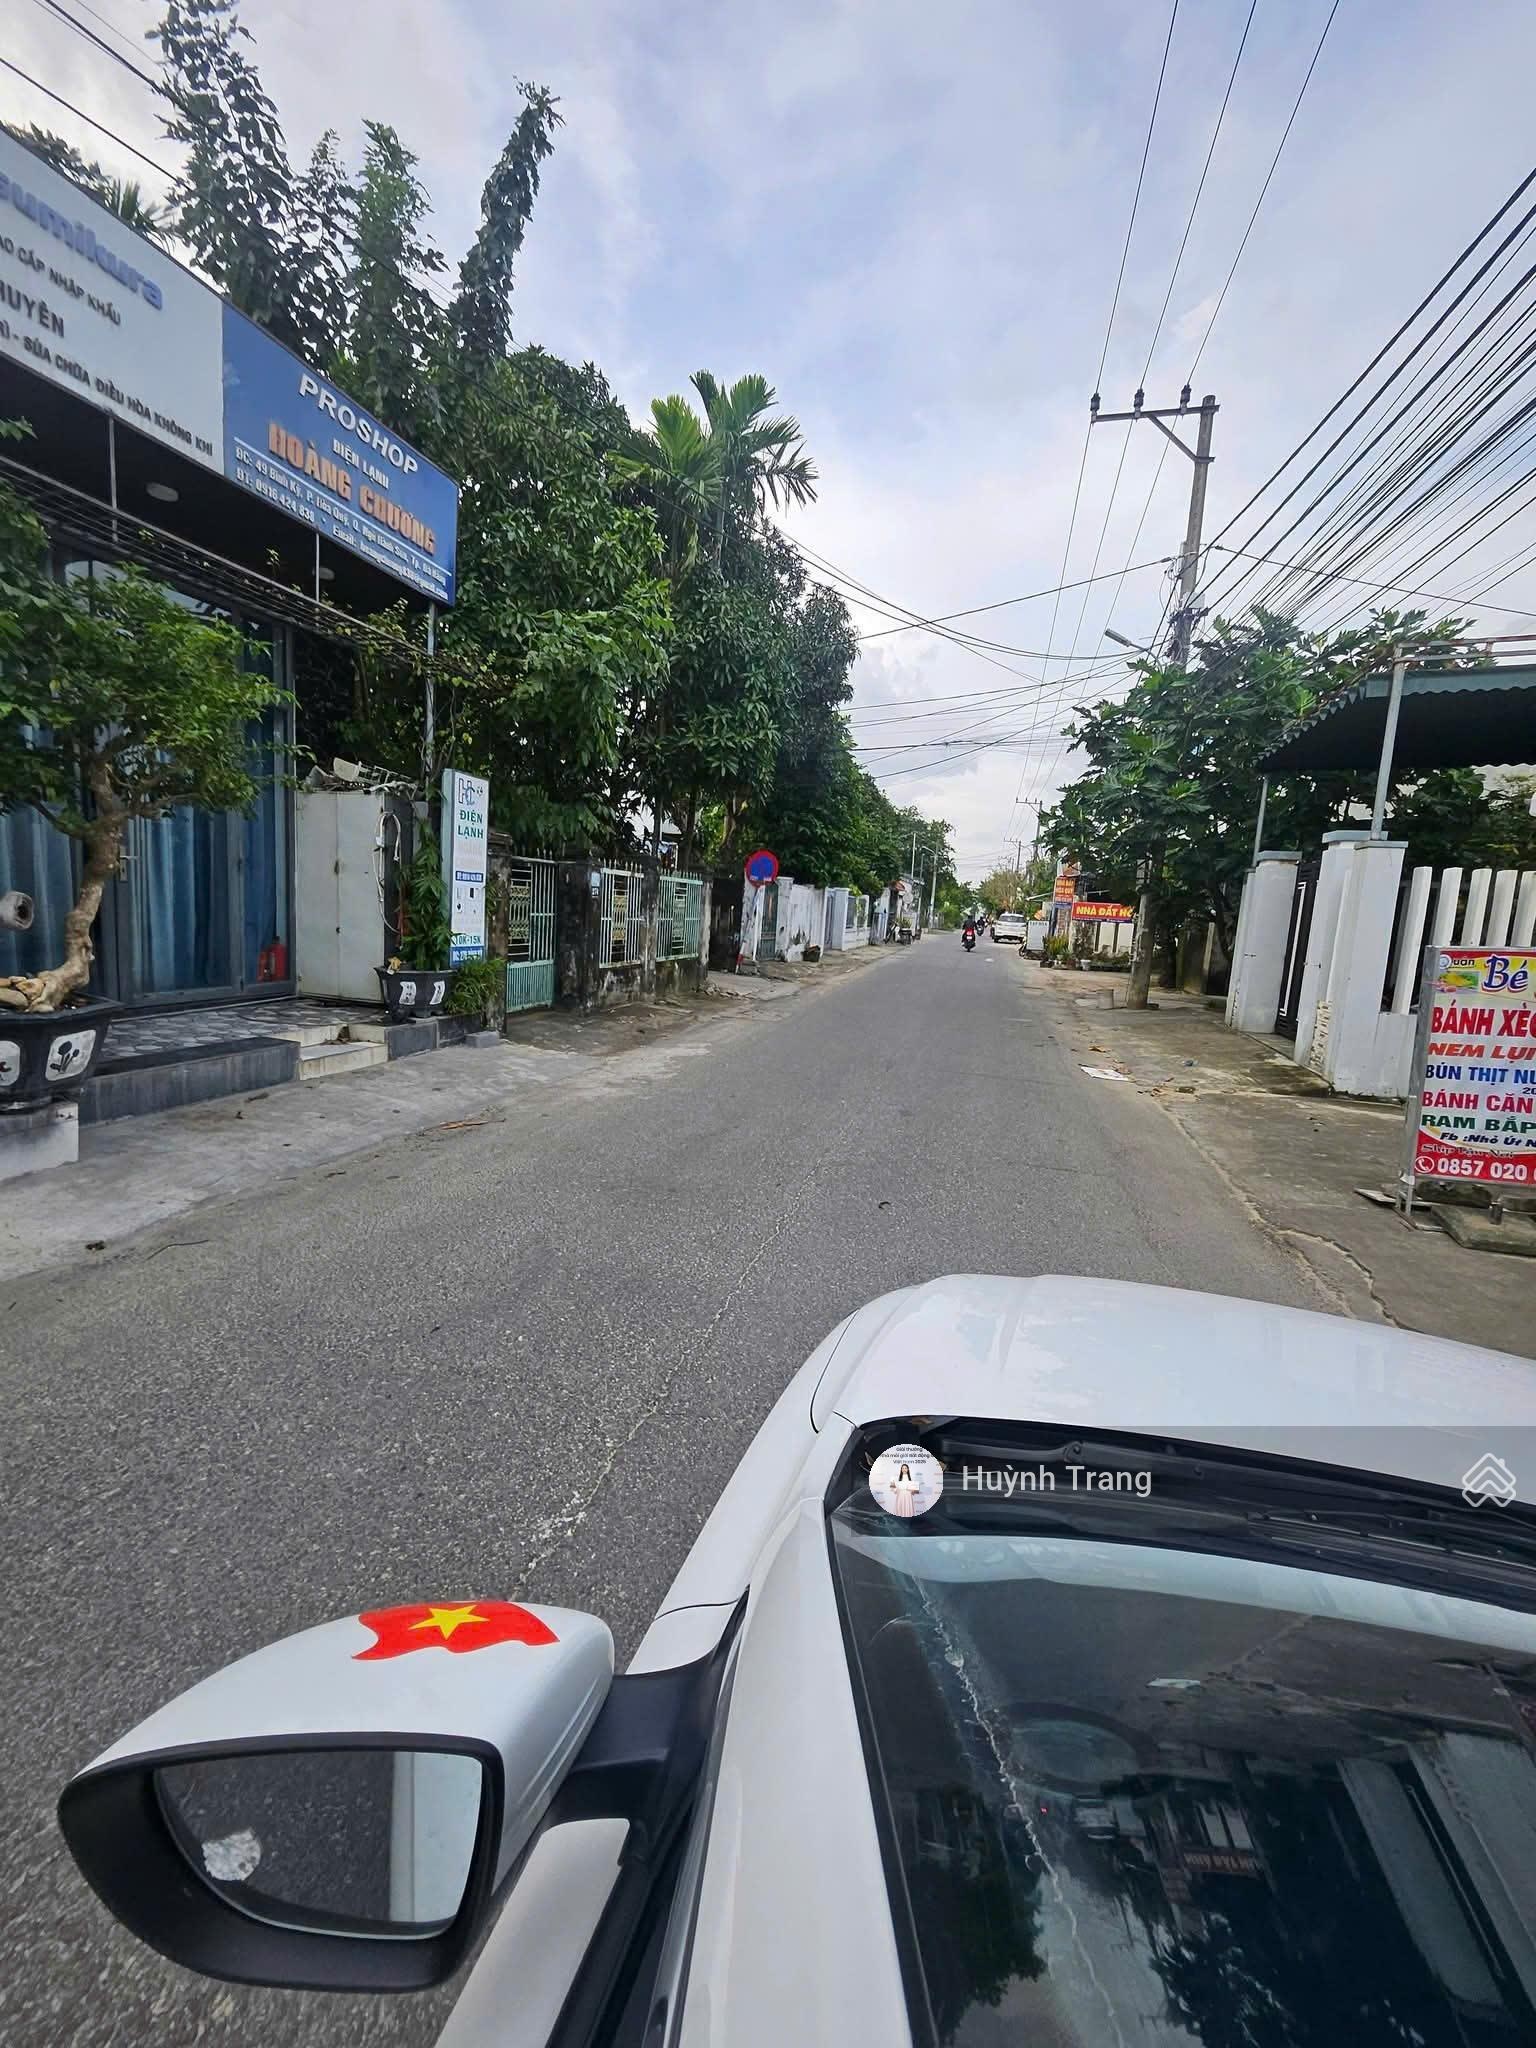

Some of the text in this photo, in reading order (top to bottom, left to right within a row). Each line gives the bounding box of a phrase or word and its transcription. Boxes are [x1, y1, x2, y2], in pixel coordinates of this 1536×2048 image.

[24, 334, 51, 363] SỬA
[56, 353, 90, 386] CHỮA
[127, 396, 151, 422] HÒA
[154, 411, 192, 445] KHÔNG
[300, 373, 418, 474] PROSHOP
[333, 438, 389, 490] ĐIỆN LẠNH
[268, 423, 436, 555] HOÀNG CHƯƠNG
[279, 494, 297, 513] 424
[459, 809, 483, 826] ĐIỆN
[457, 825, 484, 840] LẠNH
[1076, 904, 1096, 916] NHÀ
[1098, 903, 1118, 917] ĐẤT
[1483, 953, 1529, 993] Bé
[1432, 999, 1495, 1036] BÁNH
[1428, 1043, 1485, 1058] NEM
[1425, 1062, 1462, 1080] BÚN
[1468, 1066, 1509, 1086] THỊT
[1422, 1089, 1479, 1110] BÁNH
[1421, 1114, 1476, 1130] RAM
[1440, 1132, 1459, 1141] Fb
[1437, 1157, 1484, 1176] 0857
[1490, 1161, 1528, 1180] 020
